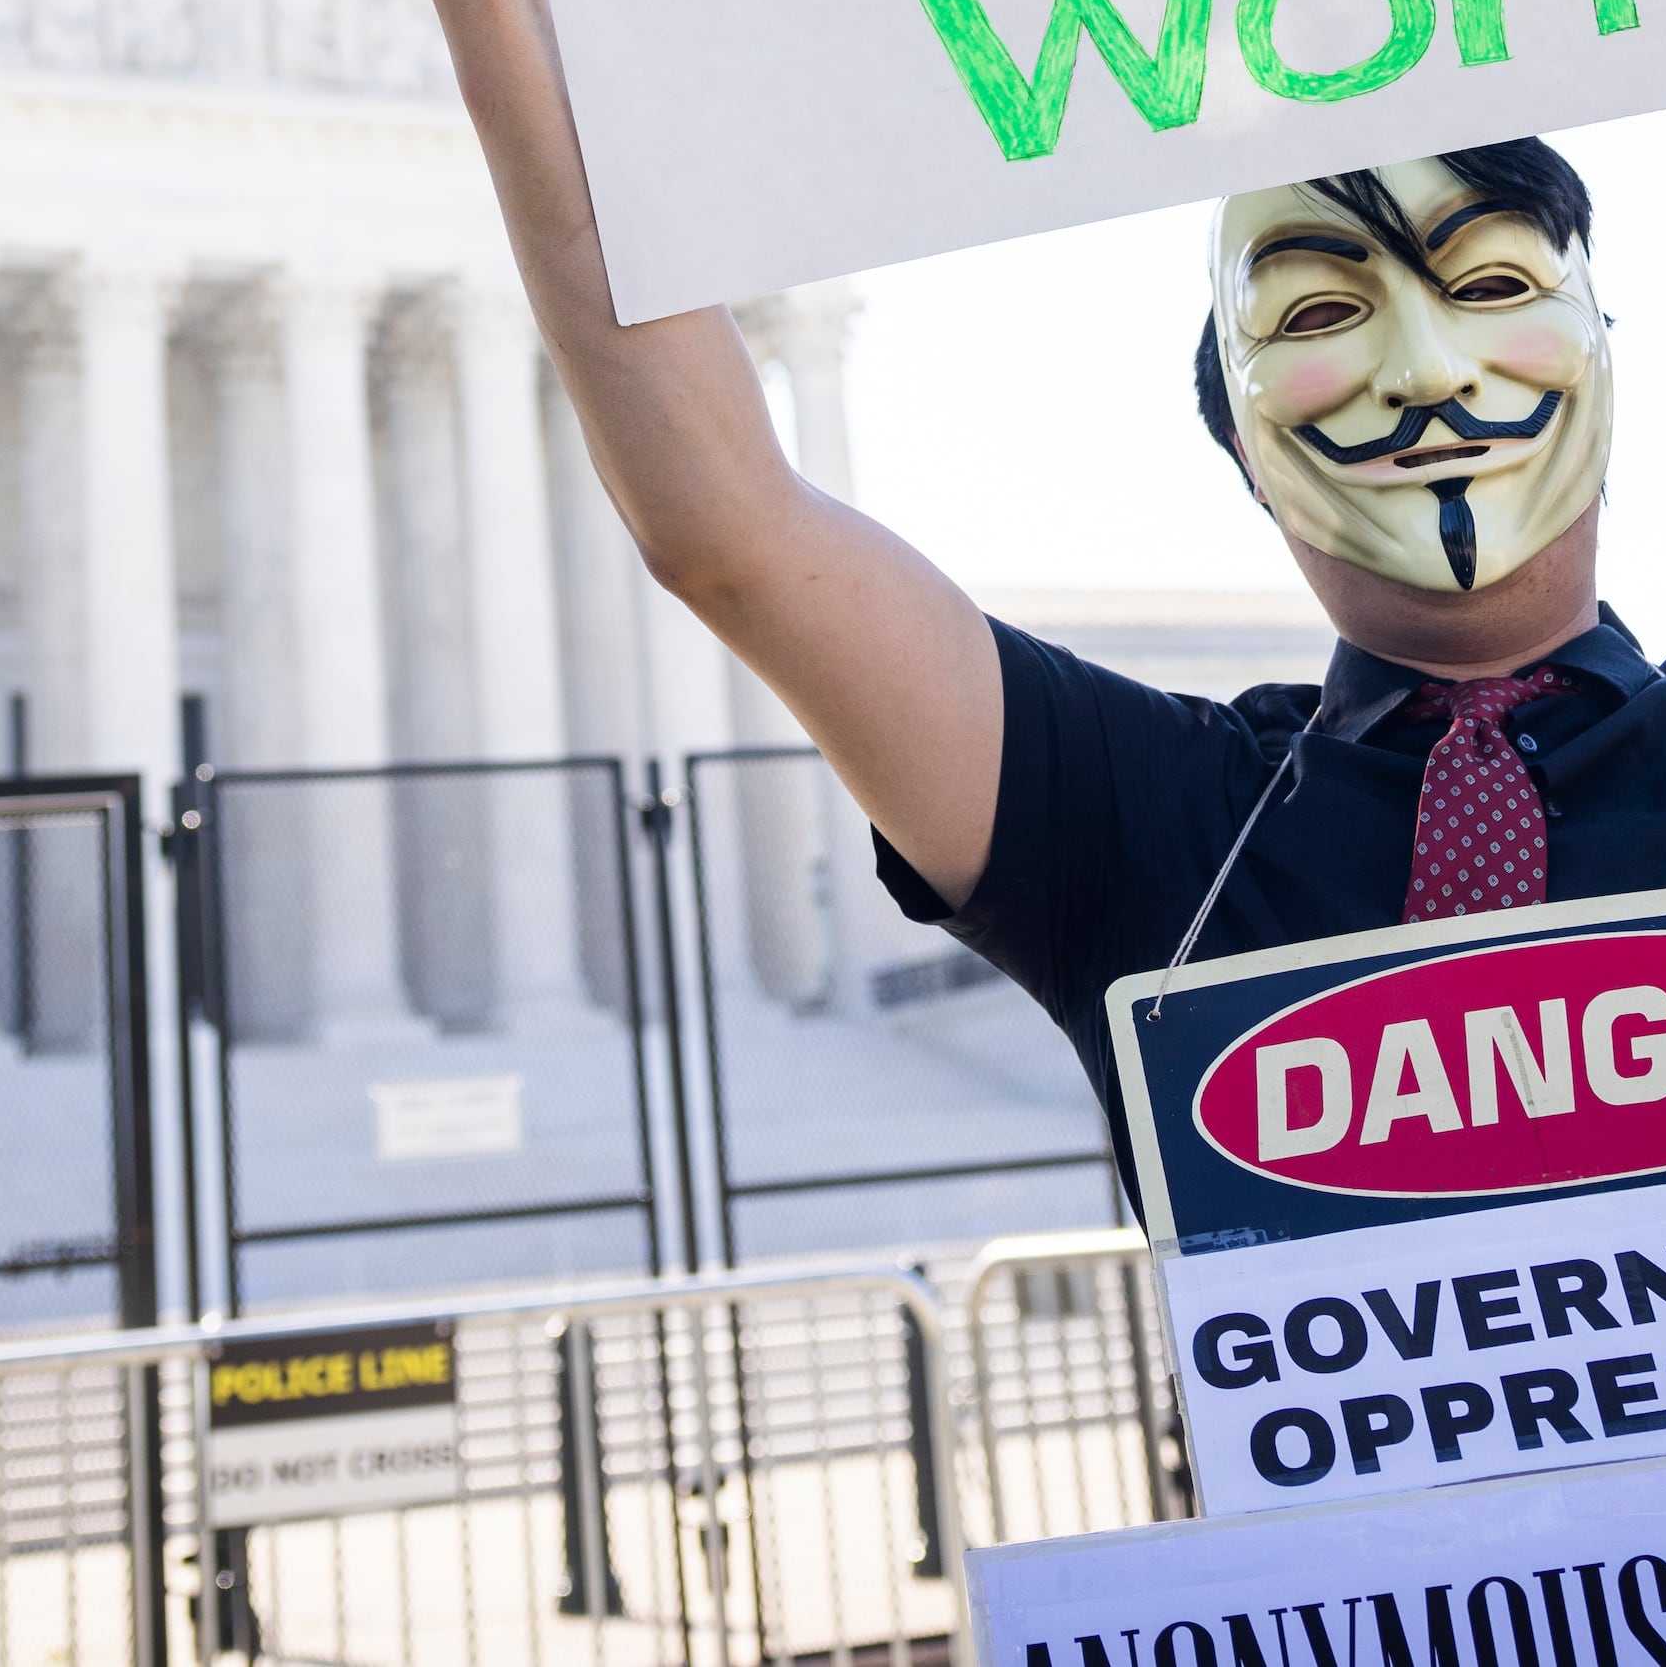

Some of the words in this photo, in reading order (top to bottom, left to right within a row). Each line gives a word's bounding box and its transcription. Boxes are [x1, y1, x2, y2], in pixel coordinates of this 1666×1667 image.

[211, 1353, 353, 1406] POLICE
[359, 1343, 449, 1390] LINE
[209, 1462, 262, 1492] DO
[272, 1451, 337, 1483] NOT
[347, 1443, 453, 1479] CROSS
